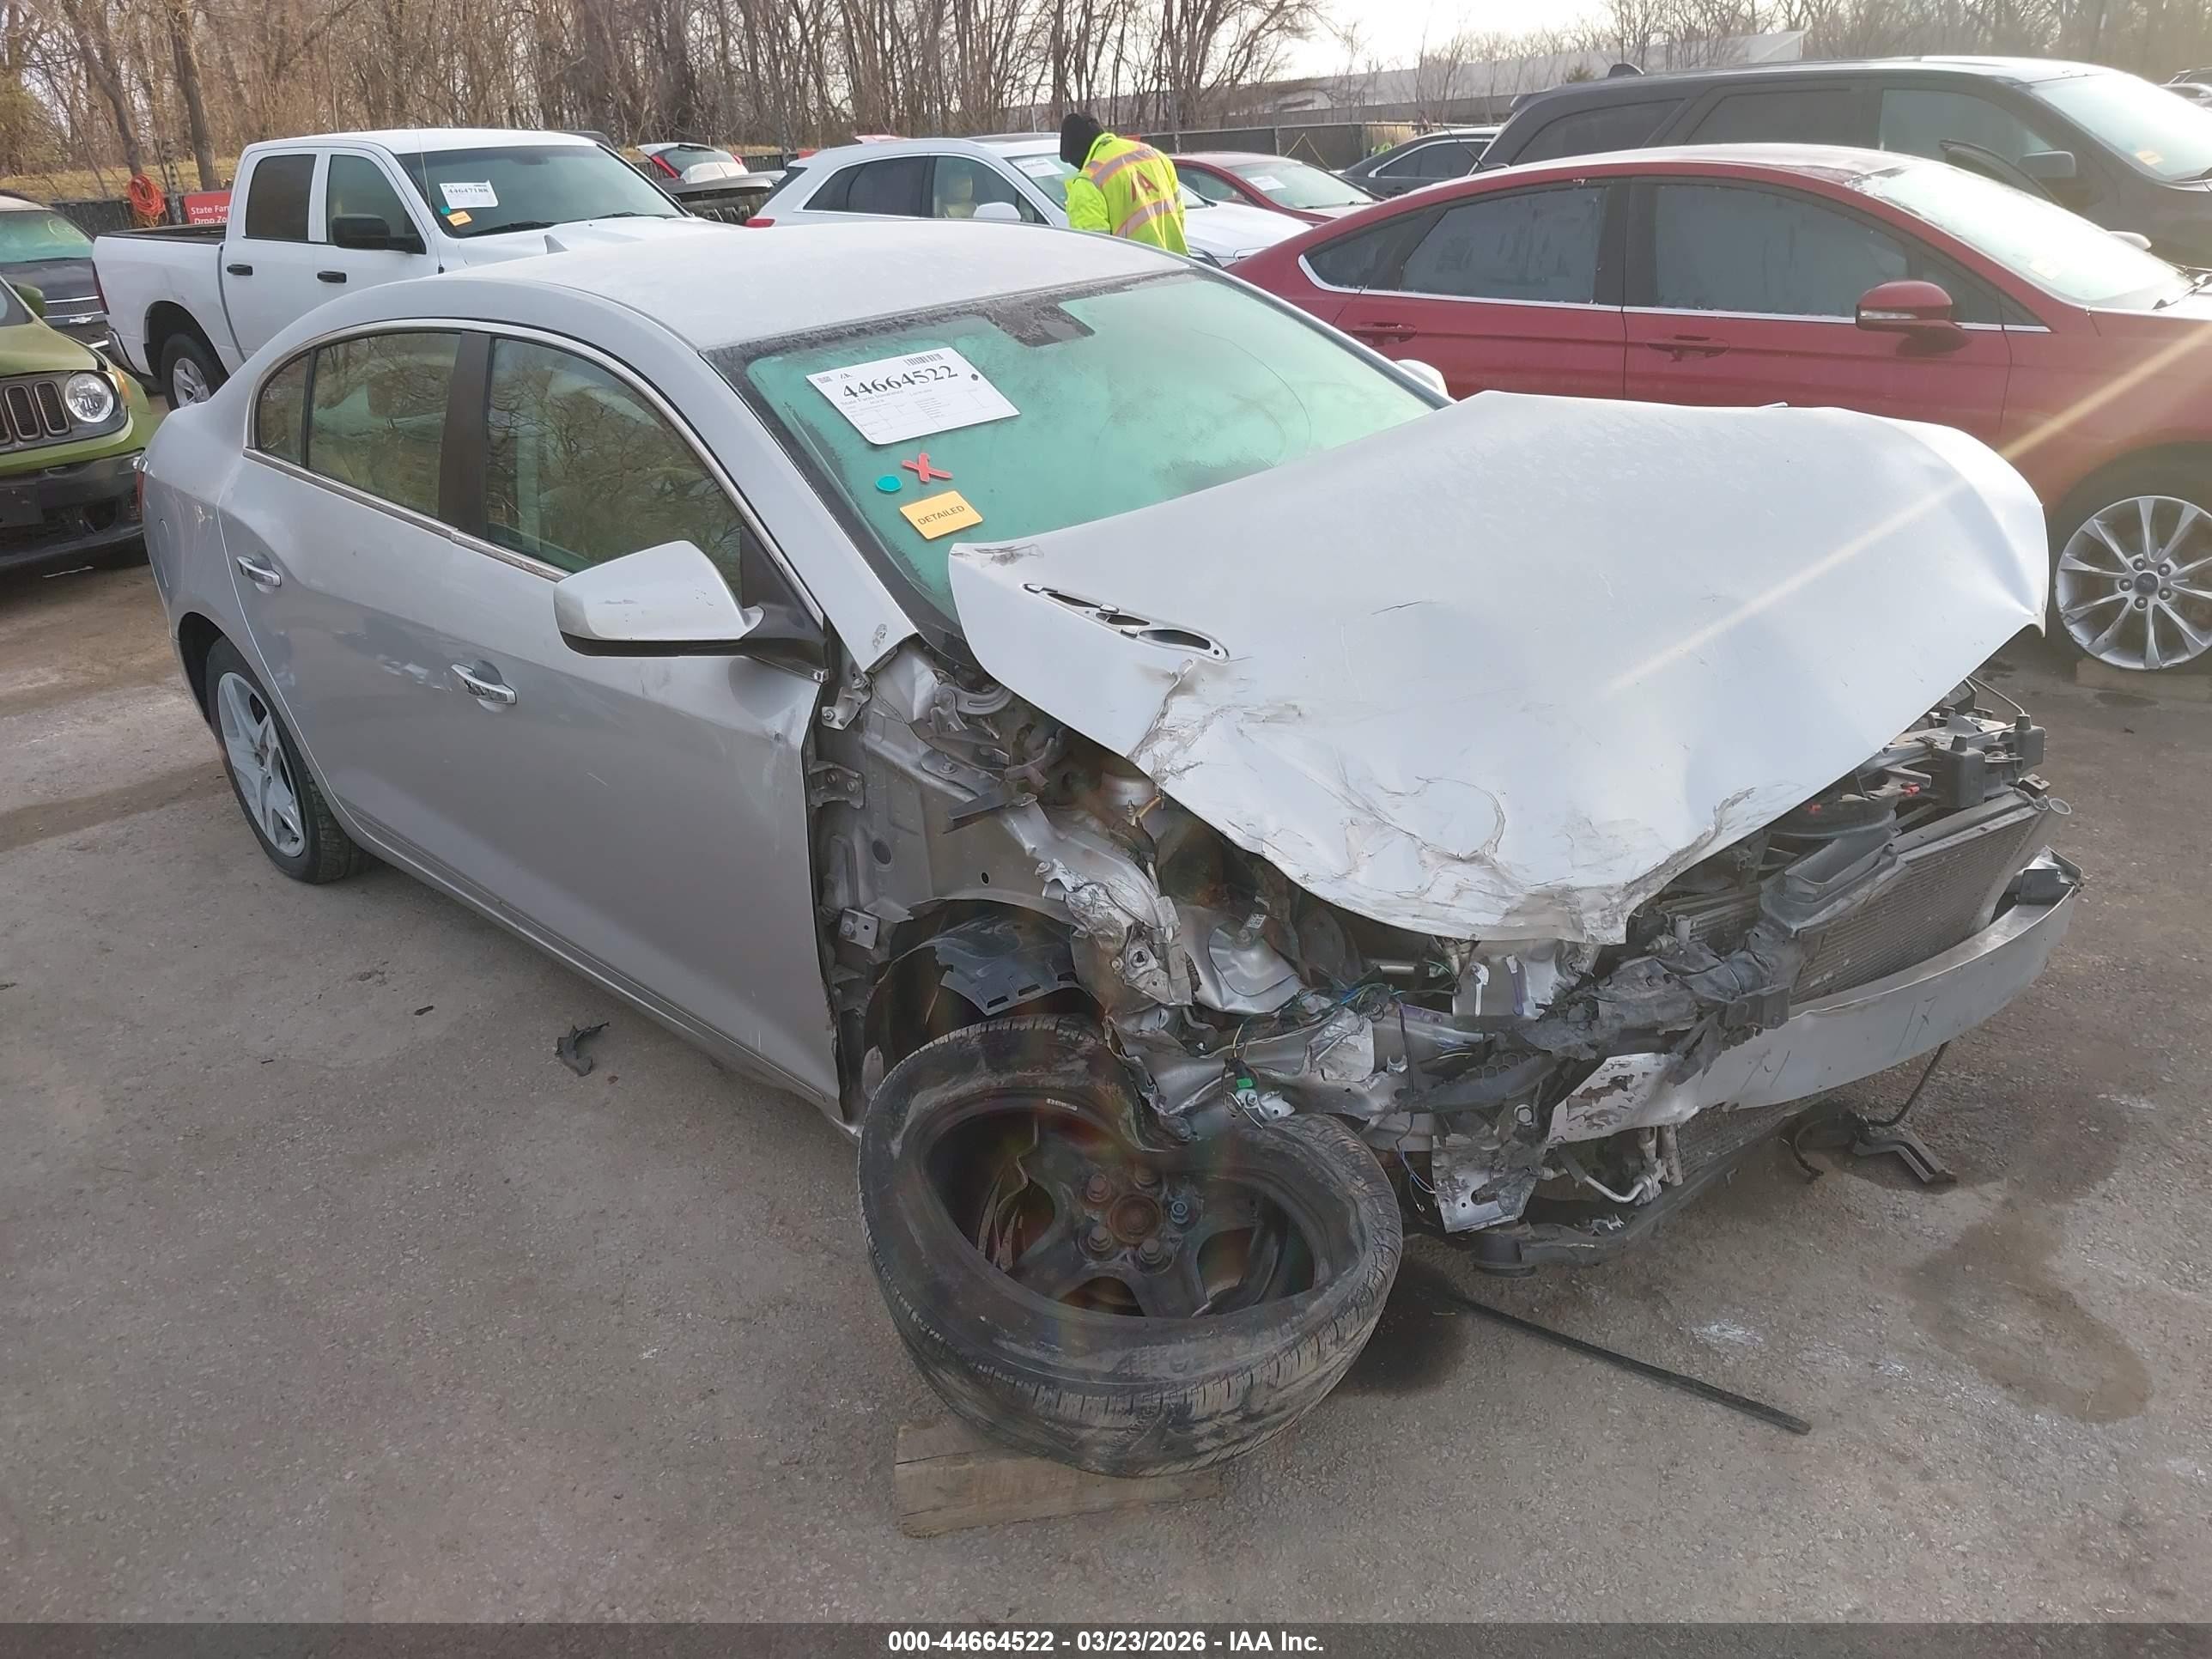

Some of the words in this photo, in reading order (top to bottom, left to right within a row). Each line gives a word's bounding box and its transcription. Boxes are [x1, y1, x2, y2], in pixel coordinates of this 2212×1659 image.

[191, 206, 213, 215] State
[215, 204, 228, 213] Far
[843, 365, 958, 398] 44664522
[918, 505, 965, 525] DETAILED
